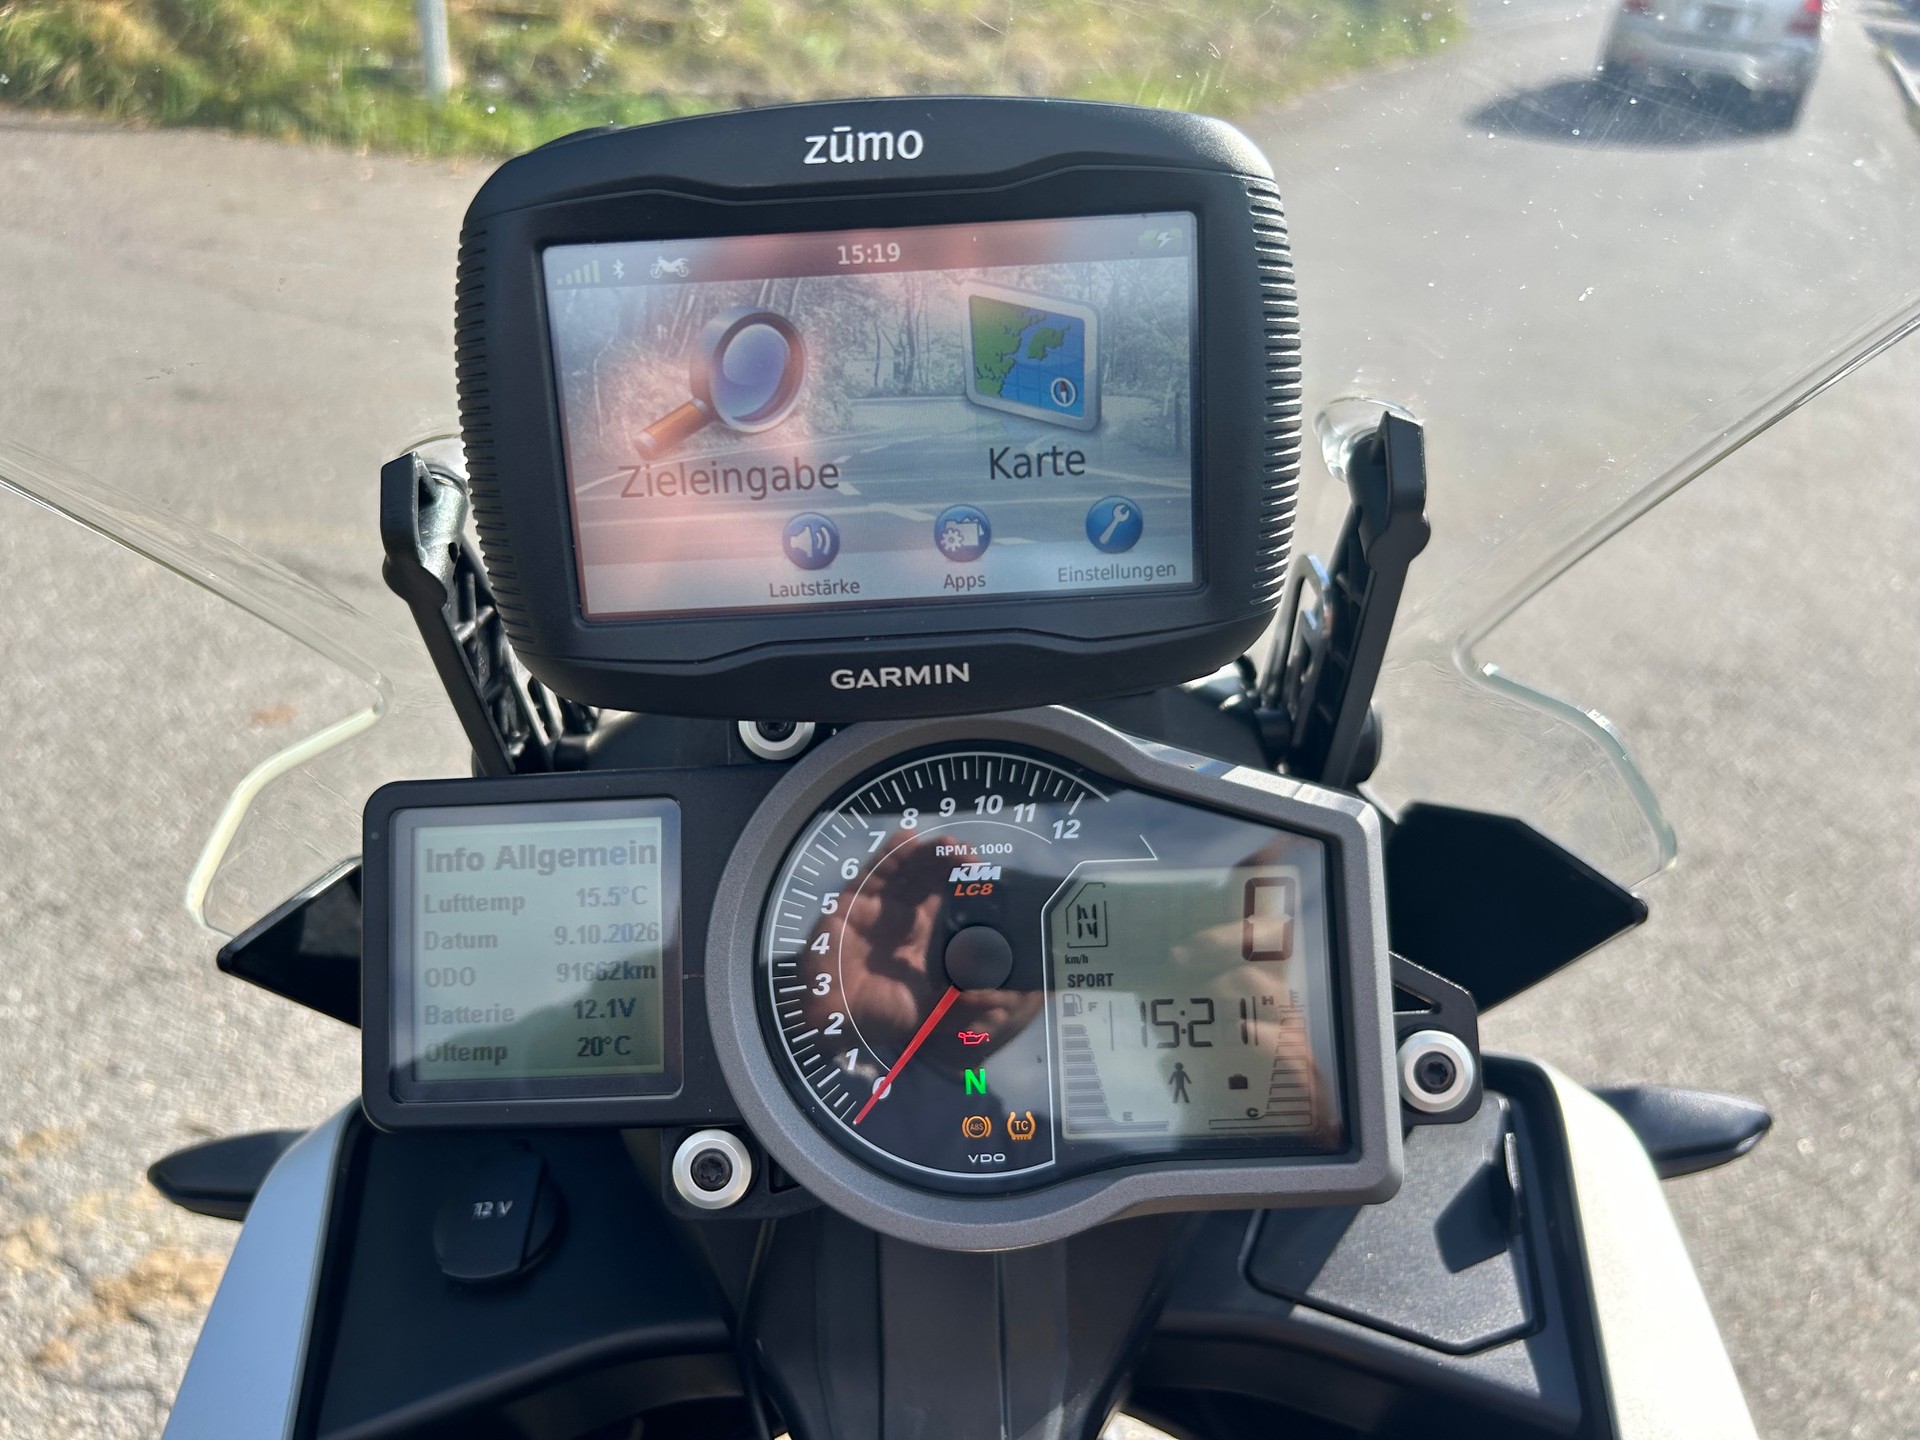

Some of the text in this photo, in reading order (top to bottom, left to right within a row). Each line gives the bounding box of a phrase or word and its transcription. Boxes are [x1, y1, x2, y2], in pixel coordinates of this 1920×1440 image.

[803, 126, 923, 164] zūmo
[837, 242, 901, 265] 15:19
[989, 444, 1086, 480] Karte
[619, 457, 840, 501] Zieleingabe
[943, 573, 986, 593] Apps
[1057, 561, 1176, 584] Einstellungen
[769, 577, 860, 598] Lautstärke
[830, 662, 970, 690] GARMIN
[939, 797, 956, 817] 9
[974, 795, 1004, 814] 10
[1013, 803, 1036, 823] 11
[899, 808, 919, 829] 8
[1052, 820, 1081, 839] 12
[867, 831, 887, 852] 7
[935, 845, 968, 857] RPM
[979, 843, 1013, 854] 1000
[425, 840, 658, 876] Info Allgemein
[841, 860, 859, 880] 6
[948, 862, 1002, 882] KTM
[953, 883, 994, 897] LC8
[424, 893, 526, 916] Lufttemp
[821, 892, 840, 914] 5
[1076, 903, 1099, 940] N
[1242, 876, 1296, 961] 0
[424, 920, 660, 951] Datum 9.10.2026
[810, 933, 831, 954] 4
[1065, 954, 1089, 965] km/h
[424, 966, 477, 988] ODO
[812, 972, 832, 995] 3
[1067, 973, 1113, 988] SPORT
[424, 998, 637, 1026] Batterie 12.1V
[1087, 1001, 1098, 1013] F
[823, 1012, 845, 1035] 2
[1140, 997, 1249, 1049] 15:21
[577, 1035, 632, 1058] 20°C
[844, 1048, 859, 1070] 1
[964, 1068, 987, 1095] N
[1122, 1110, 1133, 1121] E
[1246, 1107, 1259, 1118] C
[969, 1121, 985, 1132] ABS
[1014, 1120, 1029, 1131] TC
[967, 1152, 1006, 1164] VDO
[472, 1200, 514, 1218] 12 V
